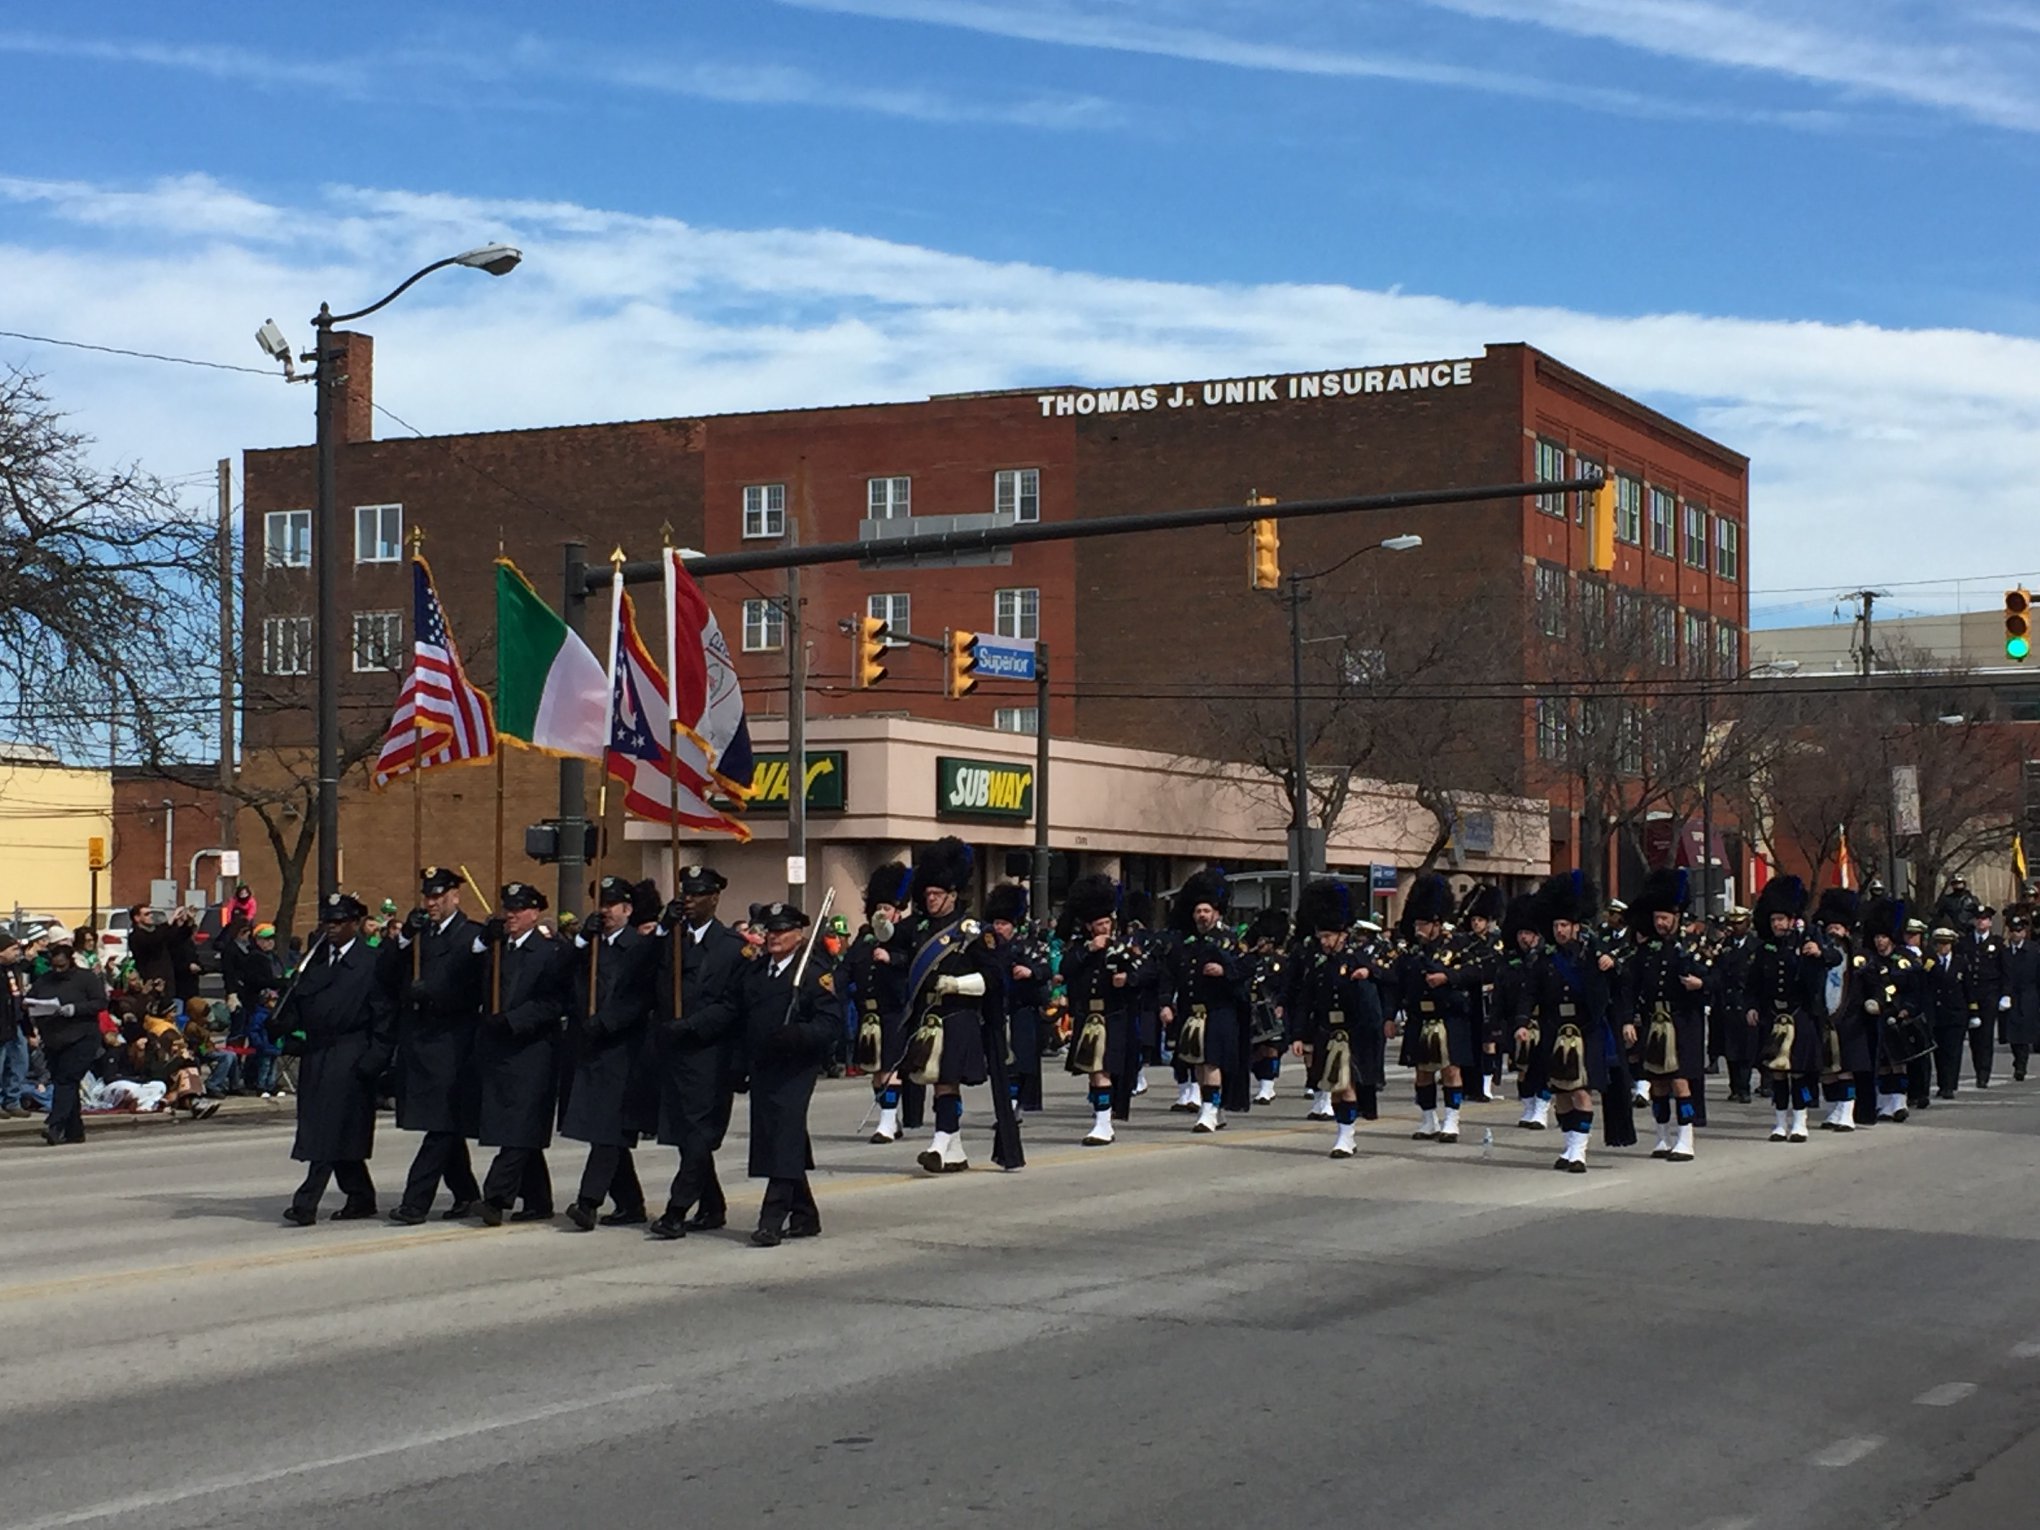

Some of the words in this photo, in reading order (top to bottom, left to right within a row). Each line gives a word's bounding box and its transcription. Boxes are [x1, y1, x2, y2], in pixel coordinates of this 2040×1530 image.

[1037, 387, 1159, 417] THOMAS
[1166, 386, 1195, 409] J.
[1203, 378, 1279, 405] UNIK
[1289, 362, 1473, 399] INSURANCE
[979, 647, 1029, 674] Superior
[949, 767, 1031, 809] SUBWAY
